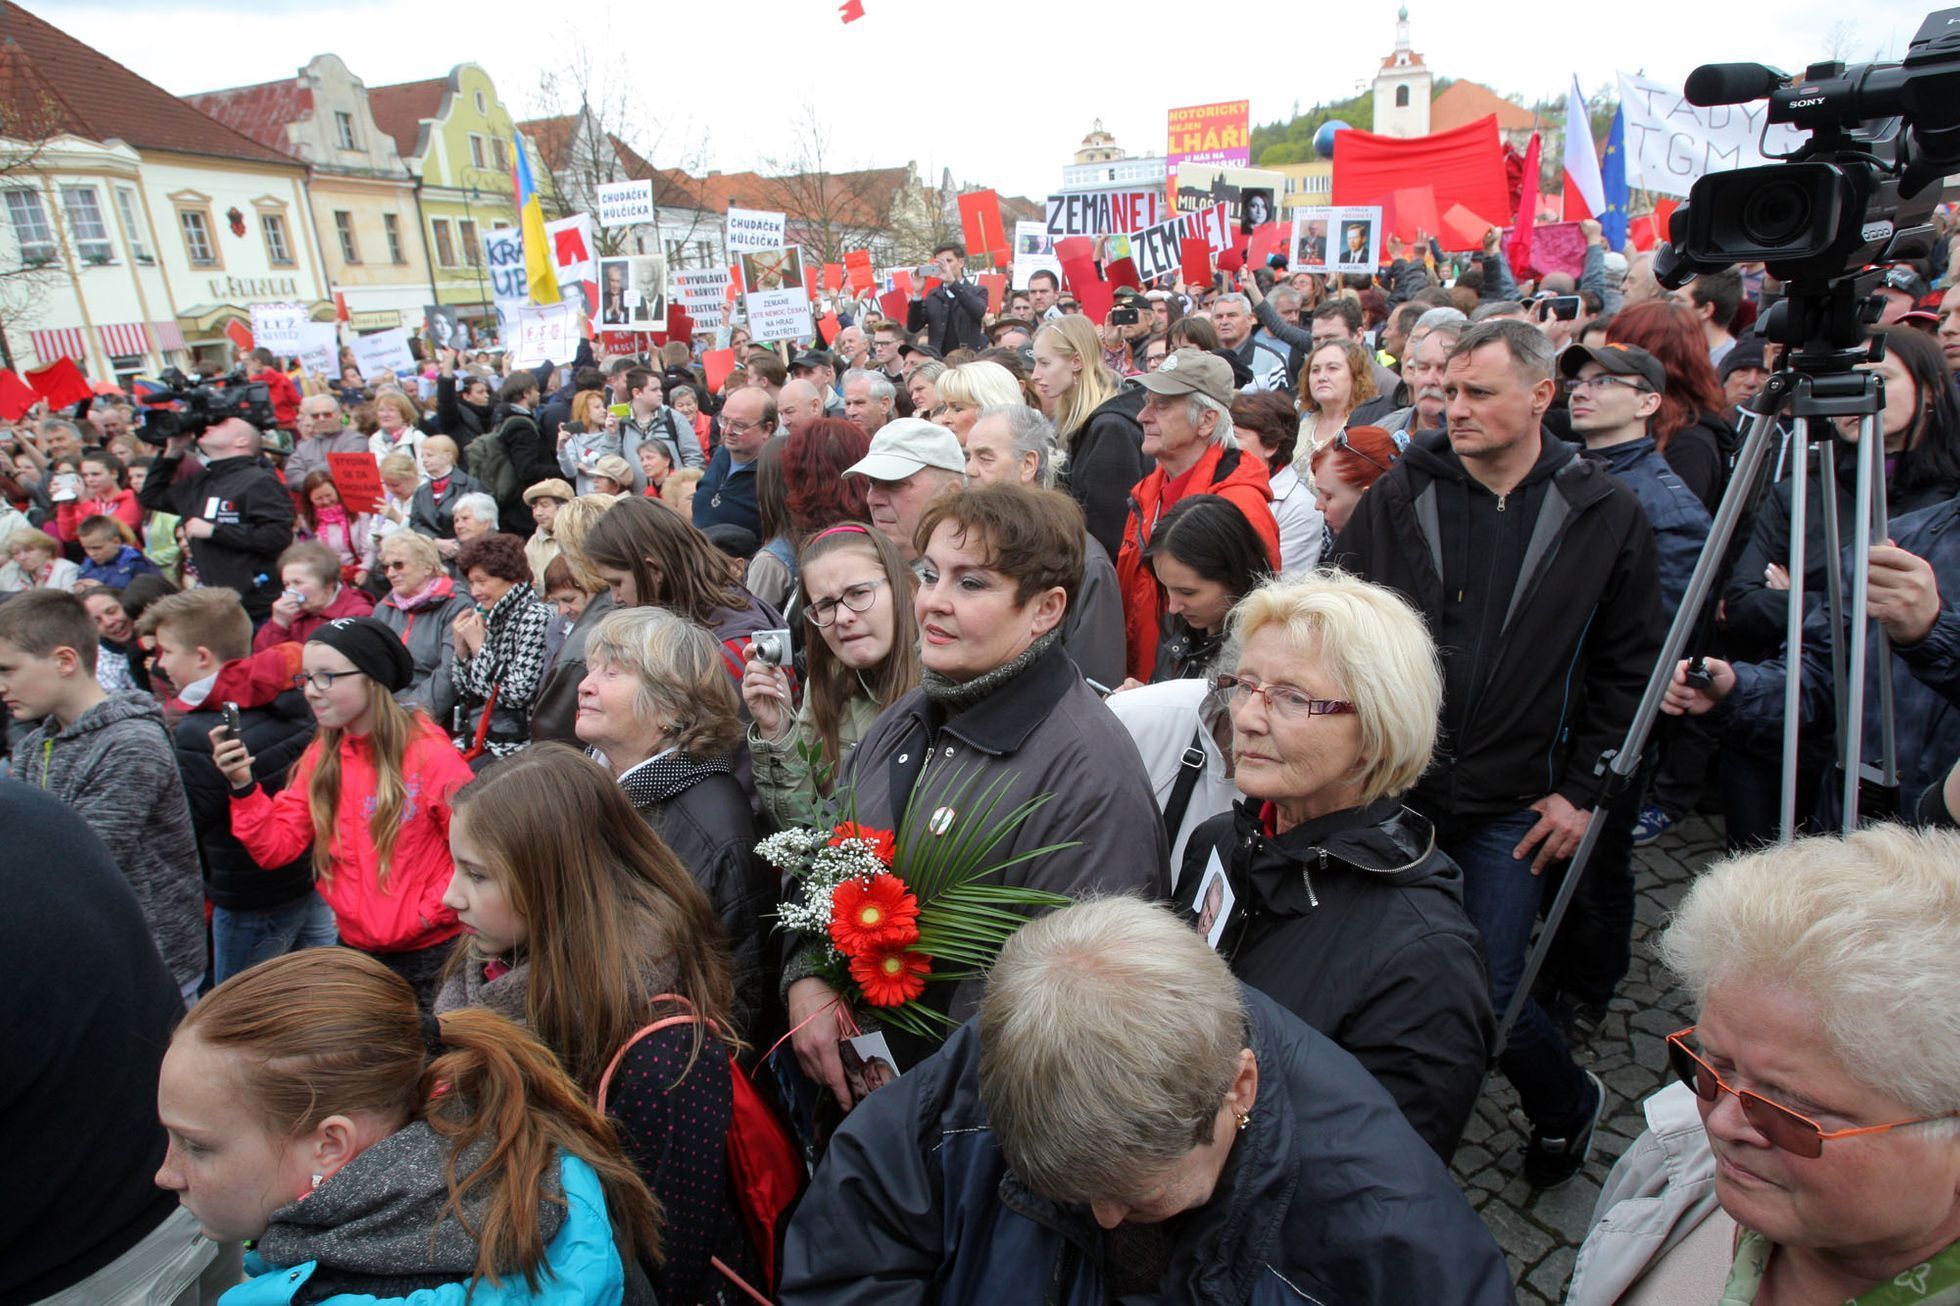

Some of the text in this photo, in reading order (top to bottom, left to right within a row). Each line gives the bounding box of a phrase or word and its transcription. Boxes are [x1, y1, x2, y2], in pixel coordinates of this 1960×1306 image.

[1635, 86, 1769, 134] TADY
[1789, 97, 1825, 109] SONY
[1047, 192, 1157, 235] ZEMANE!
[1177, 193, 1215, 211] MILOŠ
[1131, 202, 1233, 280] ZEMANE!
